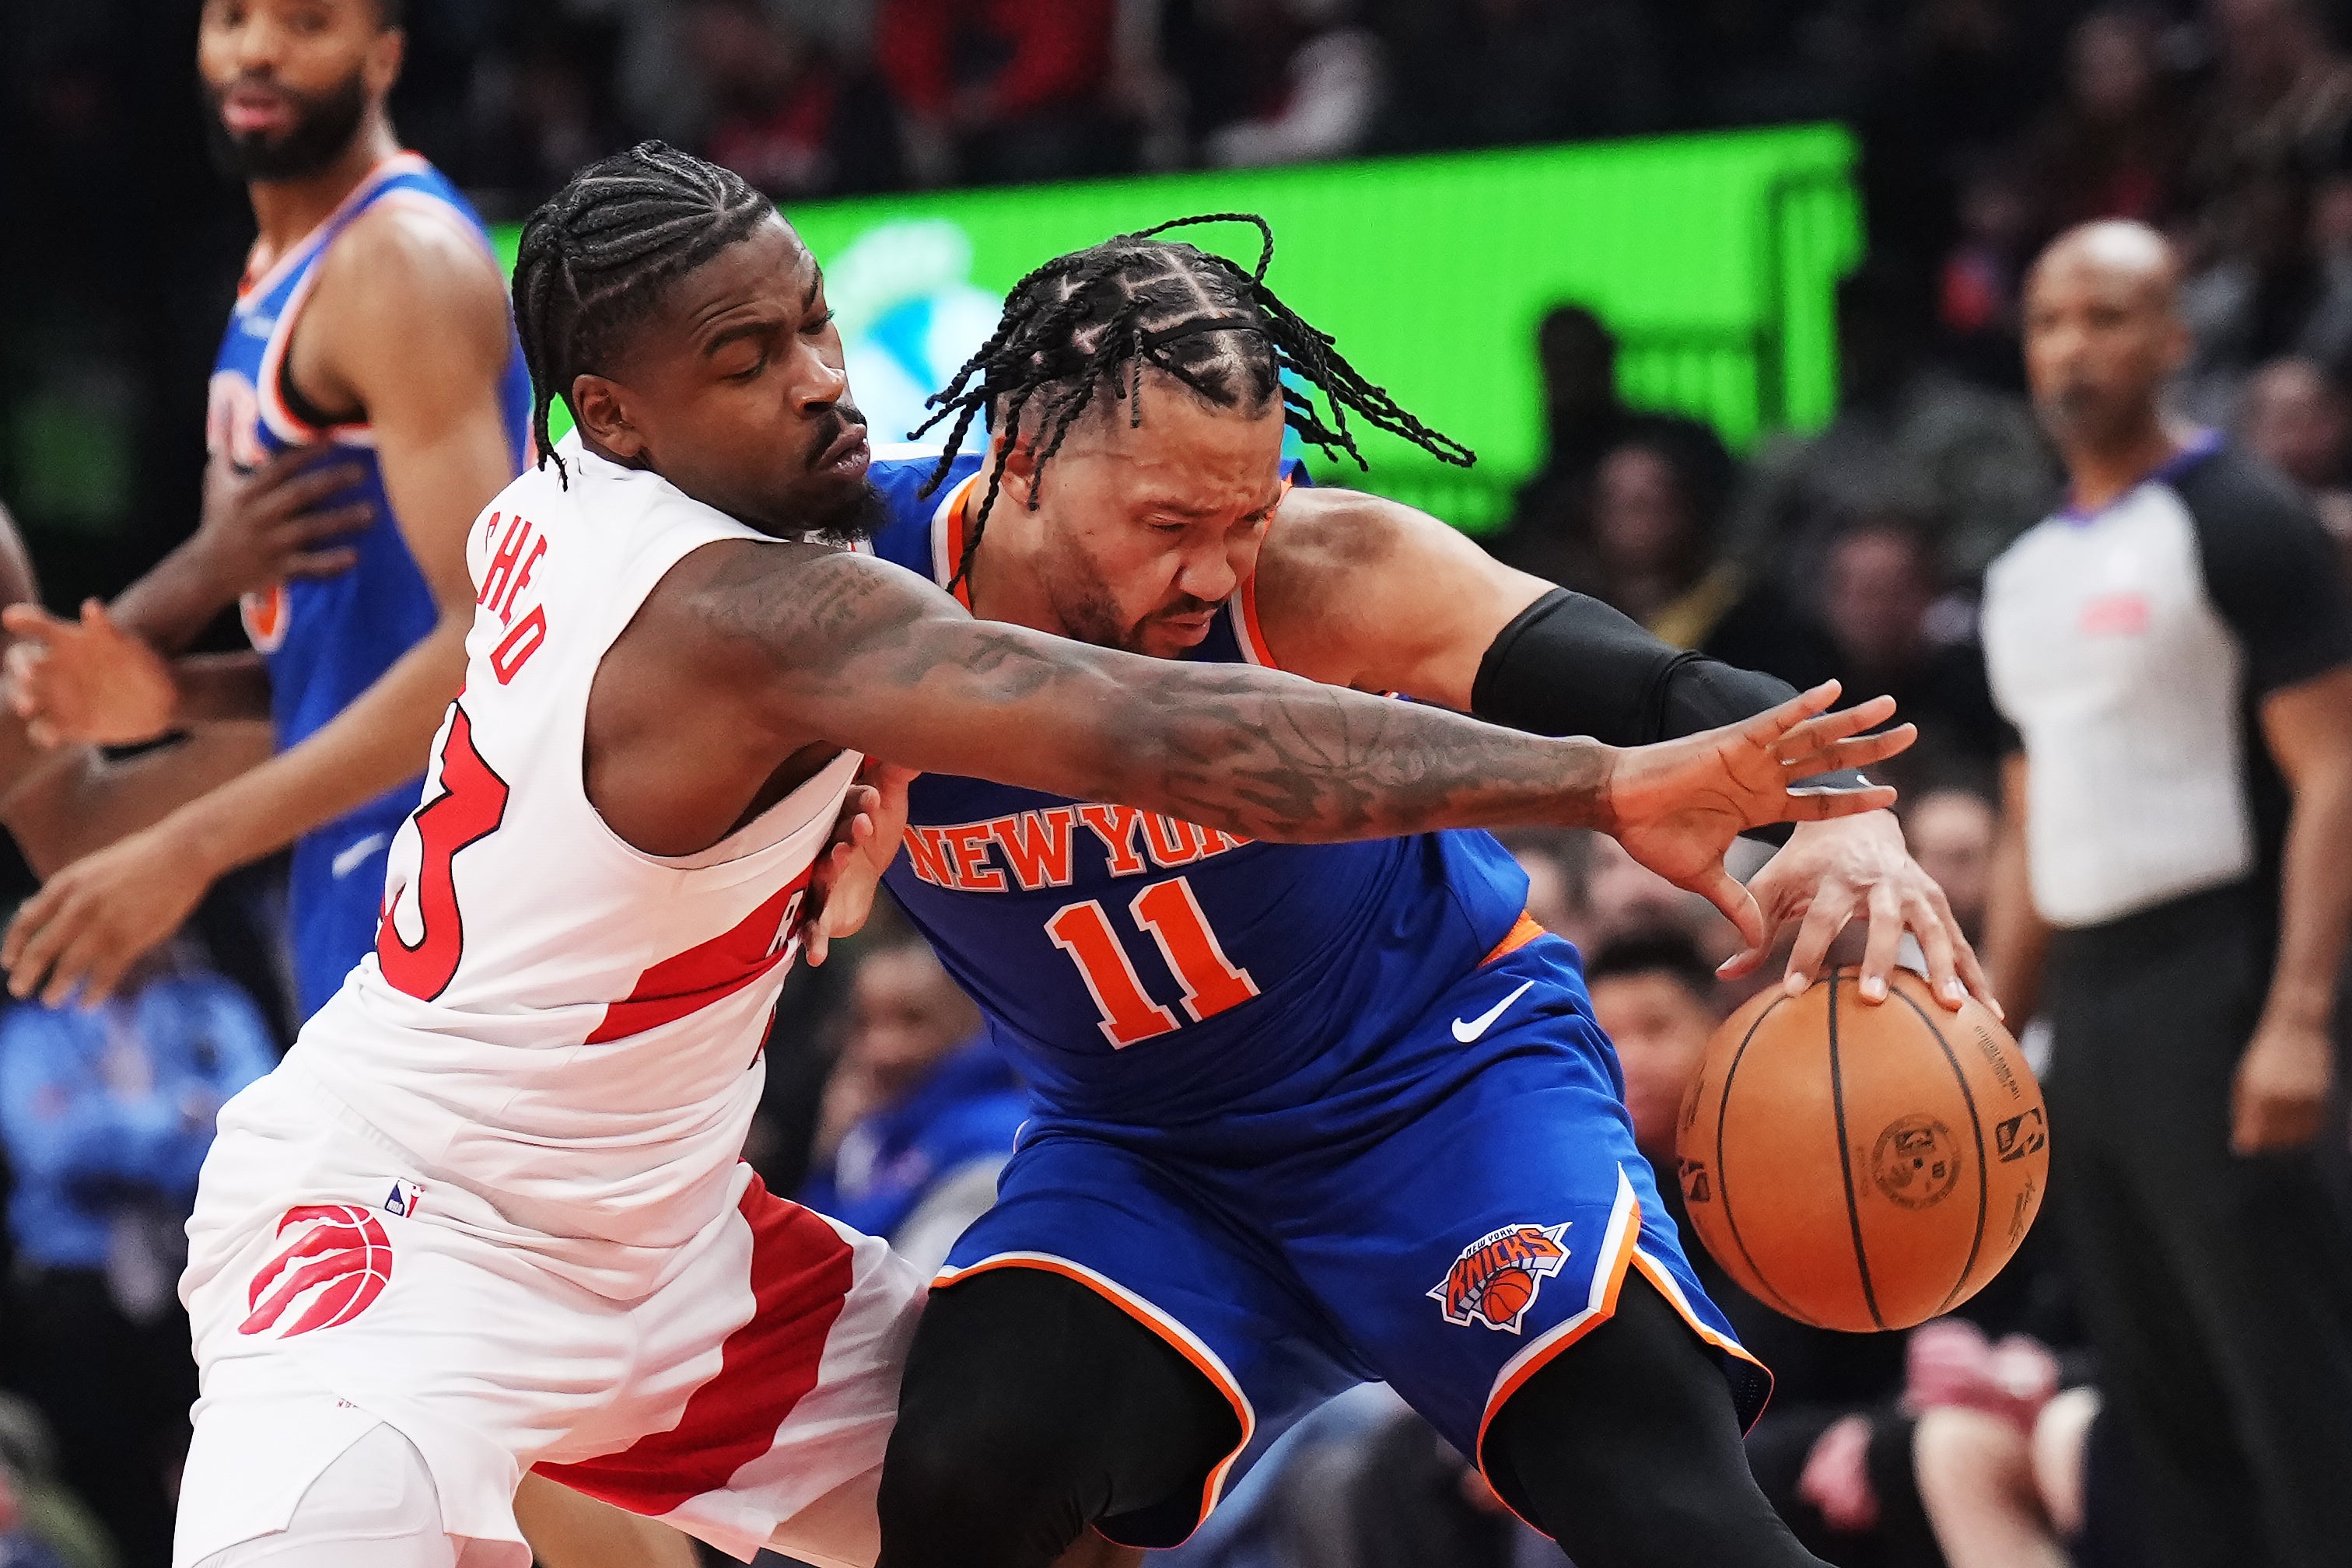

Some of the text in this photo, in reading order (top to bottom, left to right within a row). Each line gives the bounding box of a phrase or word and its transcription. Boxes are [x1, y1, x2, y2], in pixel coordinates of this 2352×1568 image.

[903, 803, 1257, 892] NEW YO
[1044, 877, 1261, 1050] 11
[1447, 1228, 1563, 1316] KNICKS
[1465, 1240, 1486, 1258] NEW
